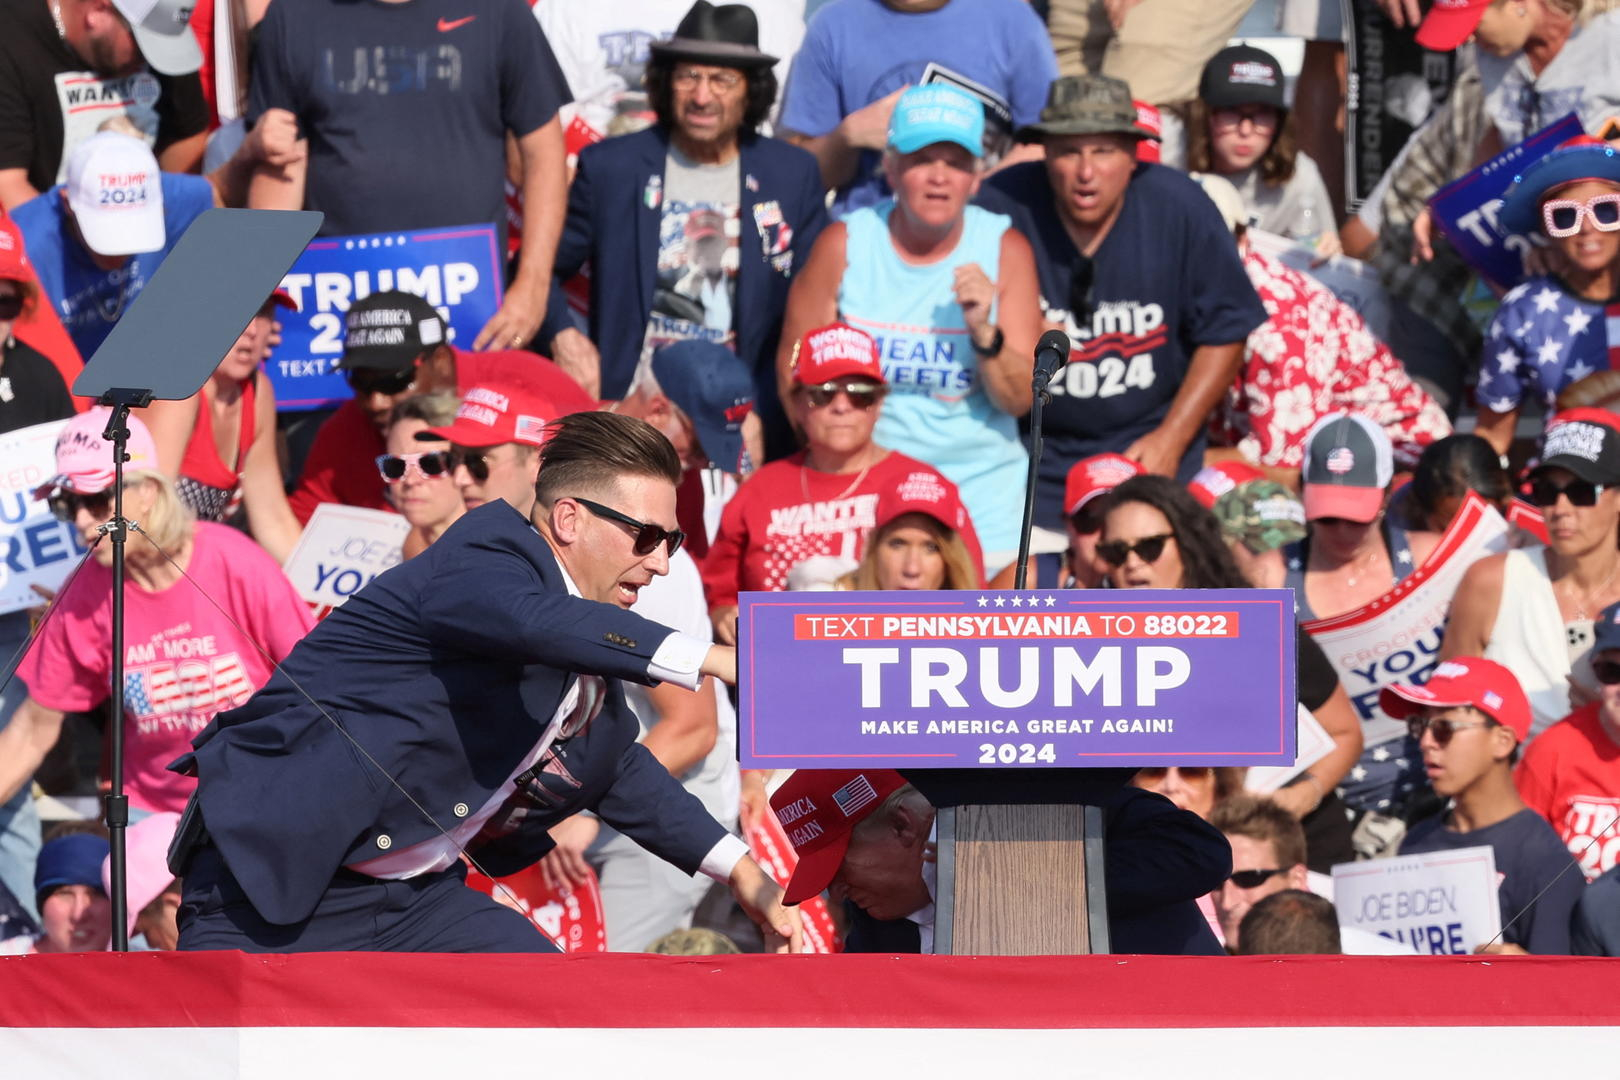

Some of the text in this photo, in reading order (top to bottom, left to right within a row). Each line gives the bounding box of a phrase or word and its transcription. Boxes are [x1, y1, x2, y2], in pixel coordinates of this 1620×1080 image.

[100, 187, 146, 204] 2024
[279, 360, 327, 377] TEXT
[807, 615, 1228, 638] TEXT PENNSYLVANIA TO 88022
[163, 635, 217, 660] MORE
[843, 646, 1190, 708] TRUMP
[861, 718, 1174, 735] MAKE AMERICA GREAT AGAIN!
[979, 743, 1056, 764] 2024
[776, 796, 817, 826] MERICA
[1354, 893, 1393, 923] JOE
